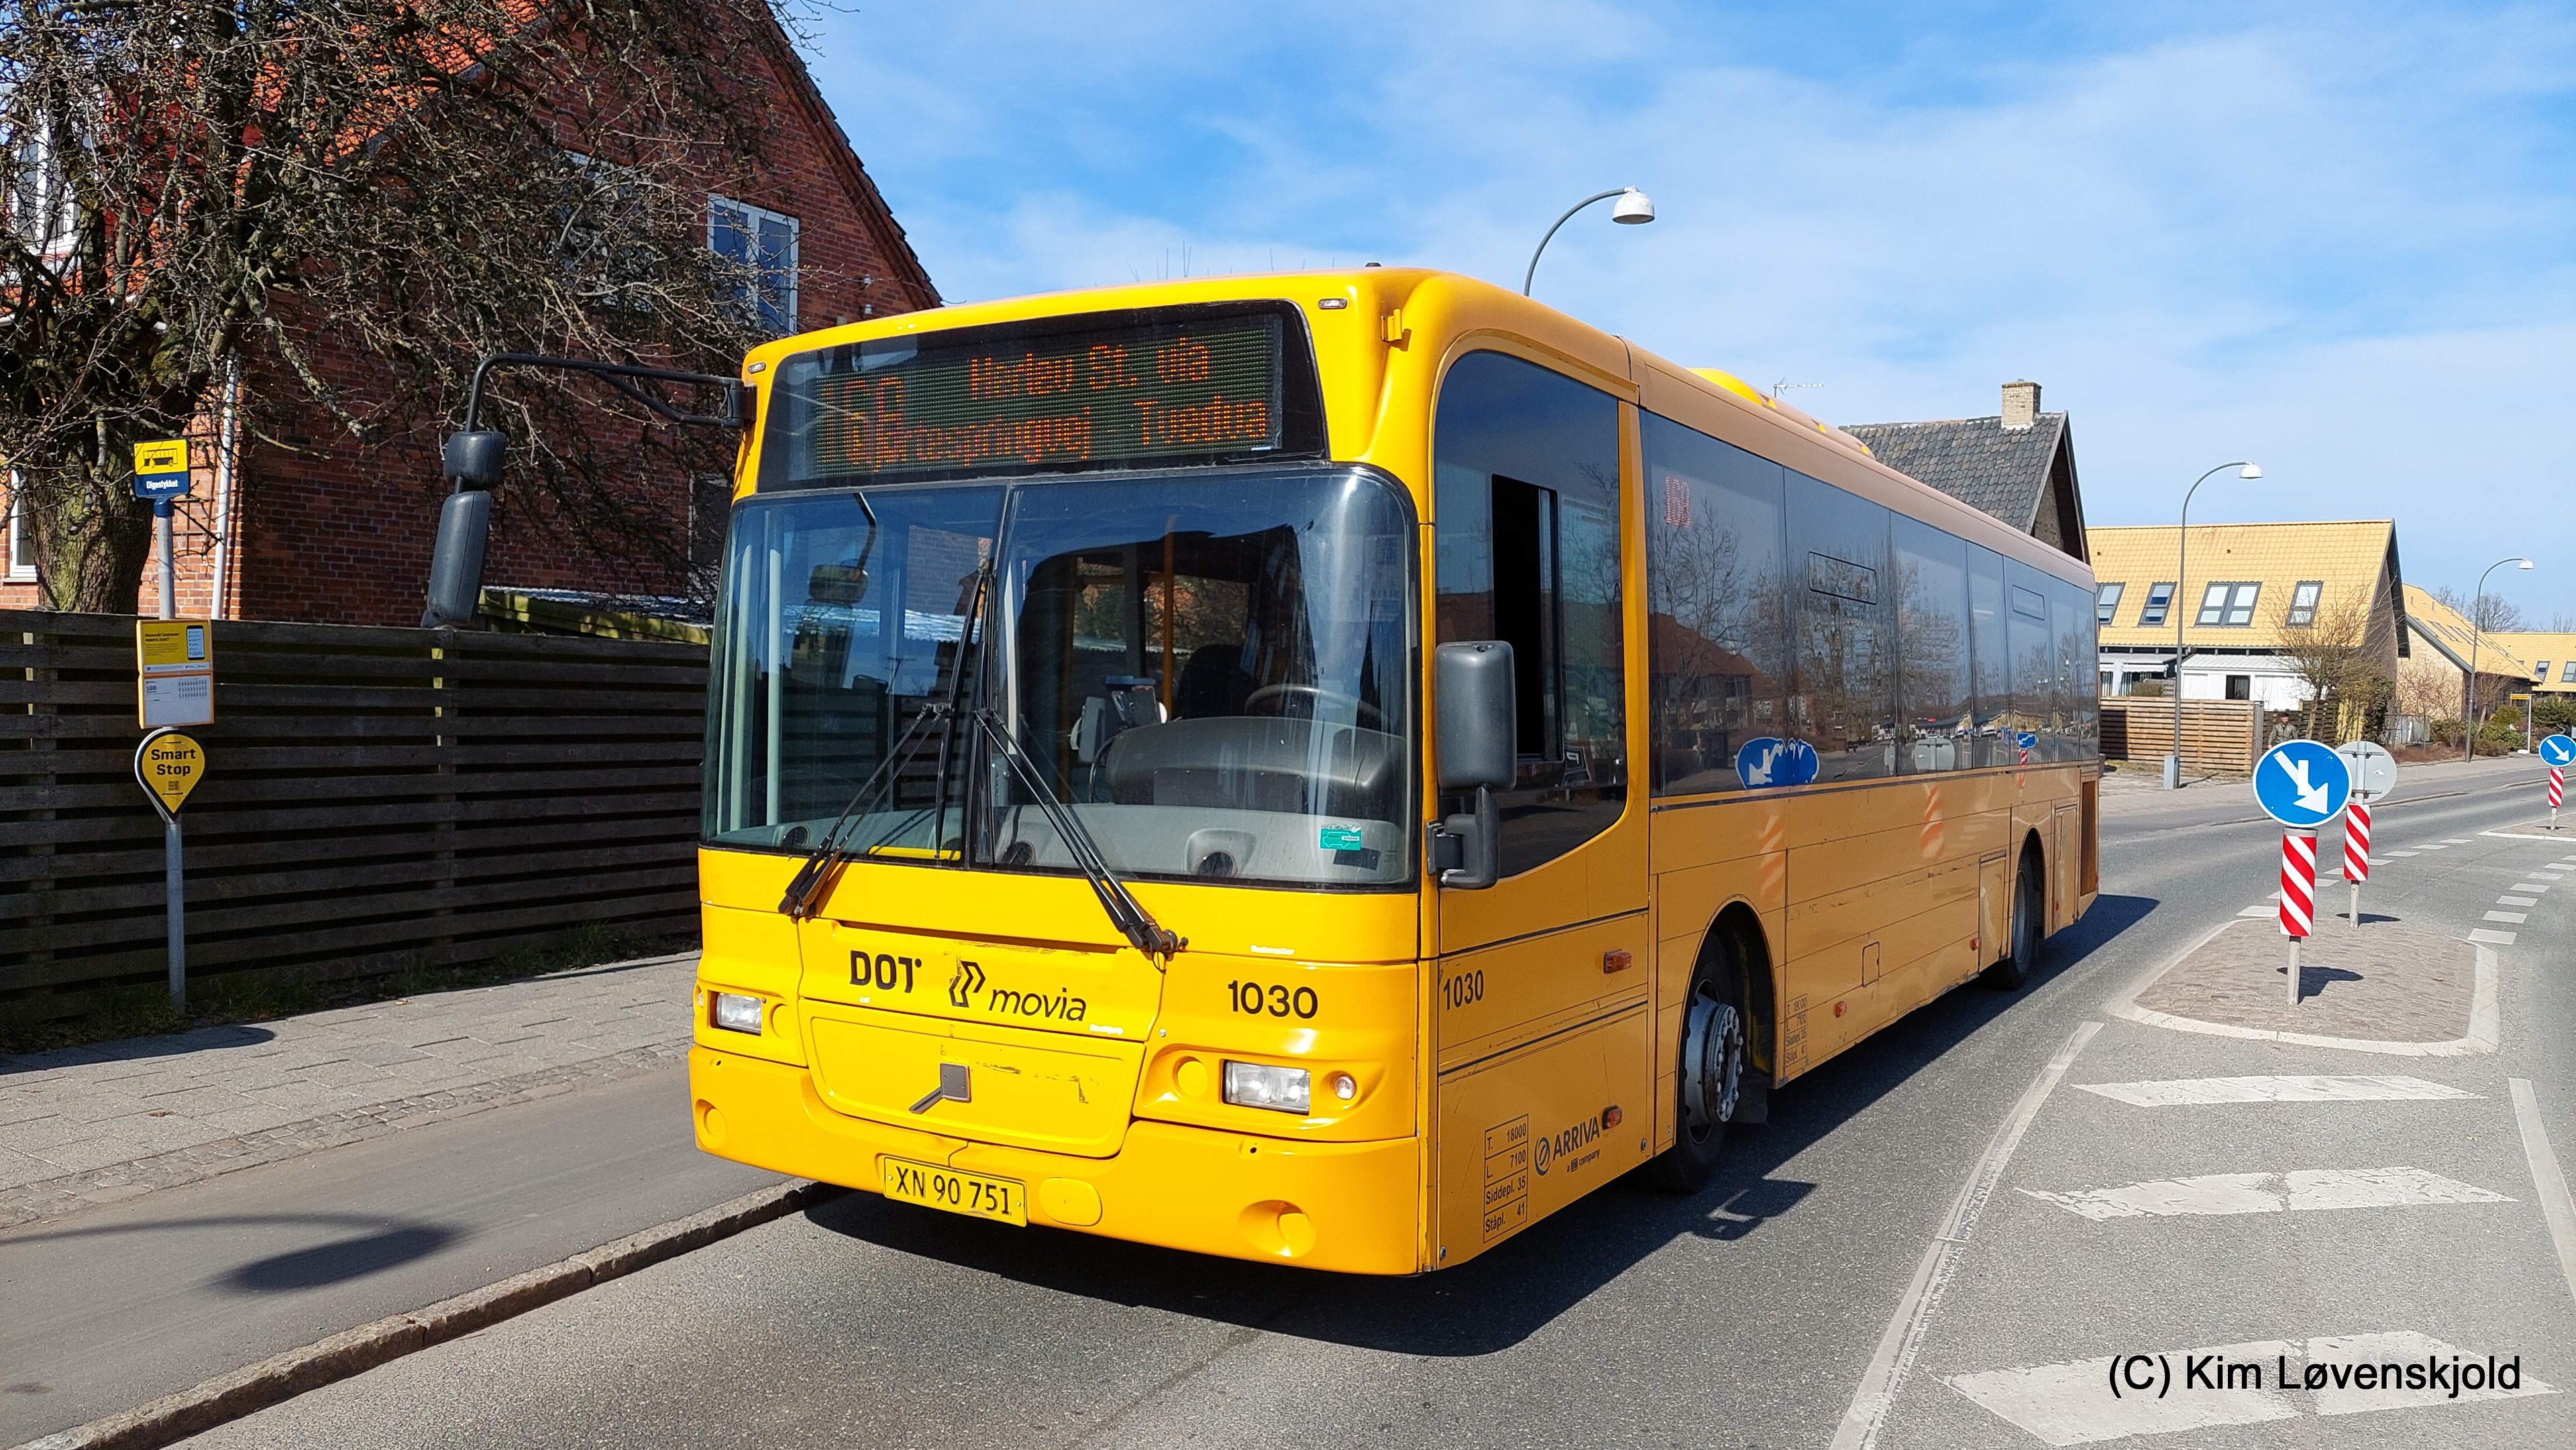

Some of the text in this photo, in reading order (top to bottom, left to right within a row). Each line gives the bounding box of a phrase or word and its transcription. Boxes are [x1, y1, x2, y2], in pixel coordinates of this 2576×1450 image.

[971, 336, 1210, 400] Herlev St. via
[146, 479, 178, 490] Digestykket
[151, 748, 197, 761] Smart
[156, 764, 191, 777] Stop
[850, 950, 922, 993] DOT
[988, 987, 1087, 1023] movia
[1228, 979, 1320, 1019] 1030
[1443, 969, 1484, 1011] 1030
[1487, 1122, 1527, 1151] T. 18000
[1552, 1116, 1601, 1162] ARRIVA
[1486, 1149, 1526, 1180] L. 7100
[1578, 1148, 1601, 1166] company
[896, 1166, 1012, 1216] XN 90 751
[1485, 1175, 1526, 1205] Siddepl. 35
[1485, 1201, 1525, 1233] Ståpl. 41
